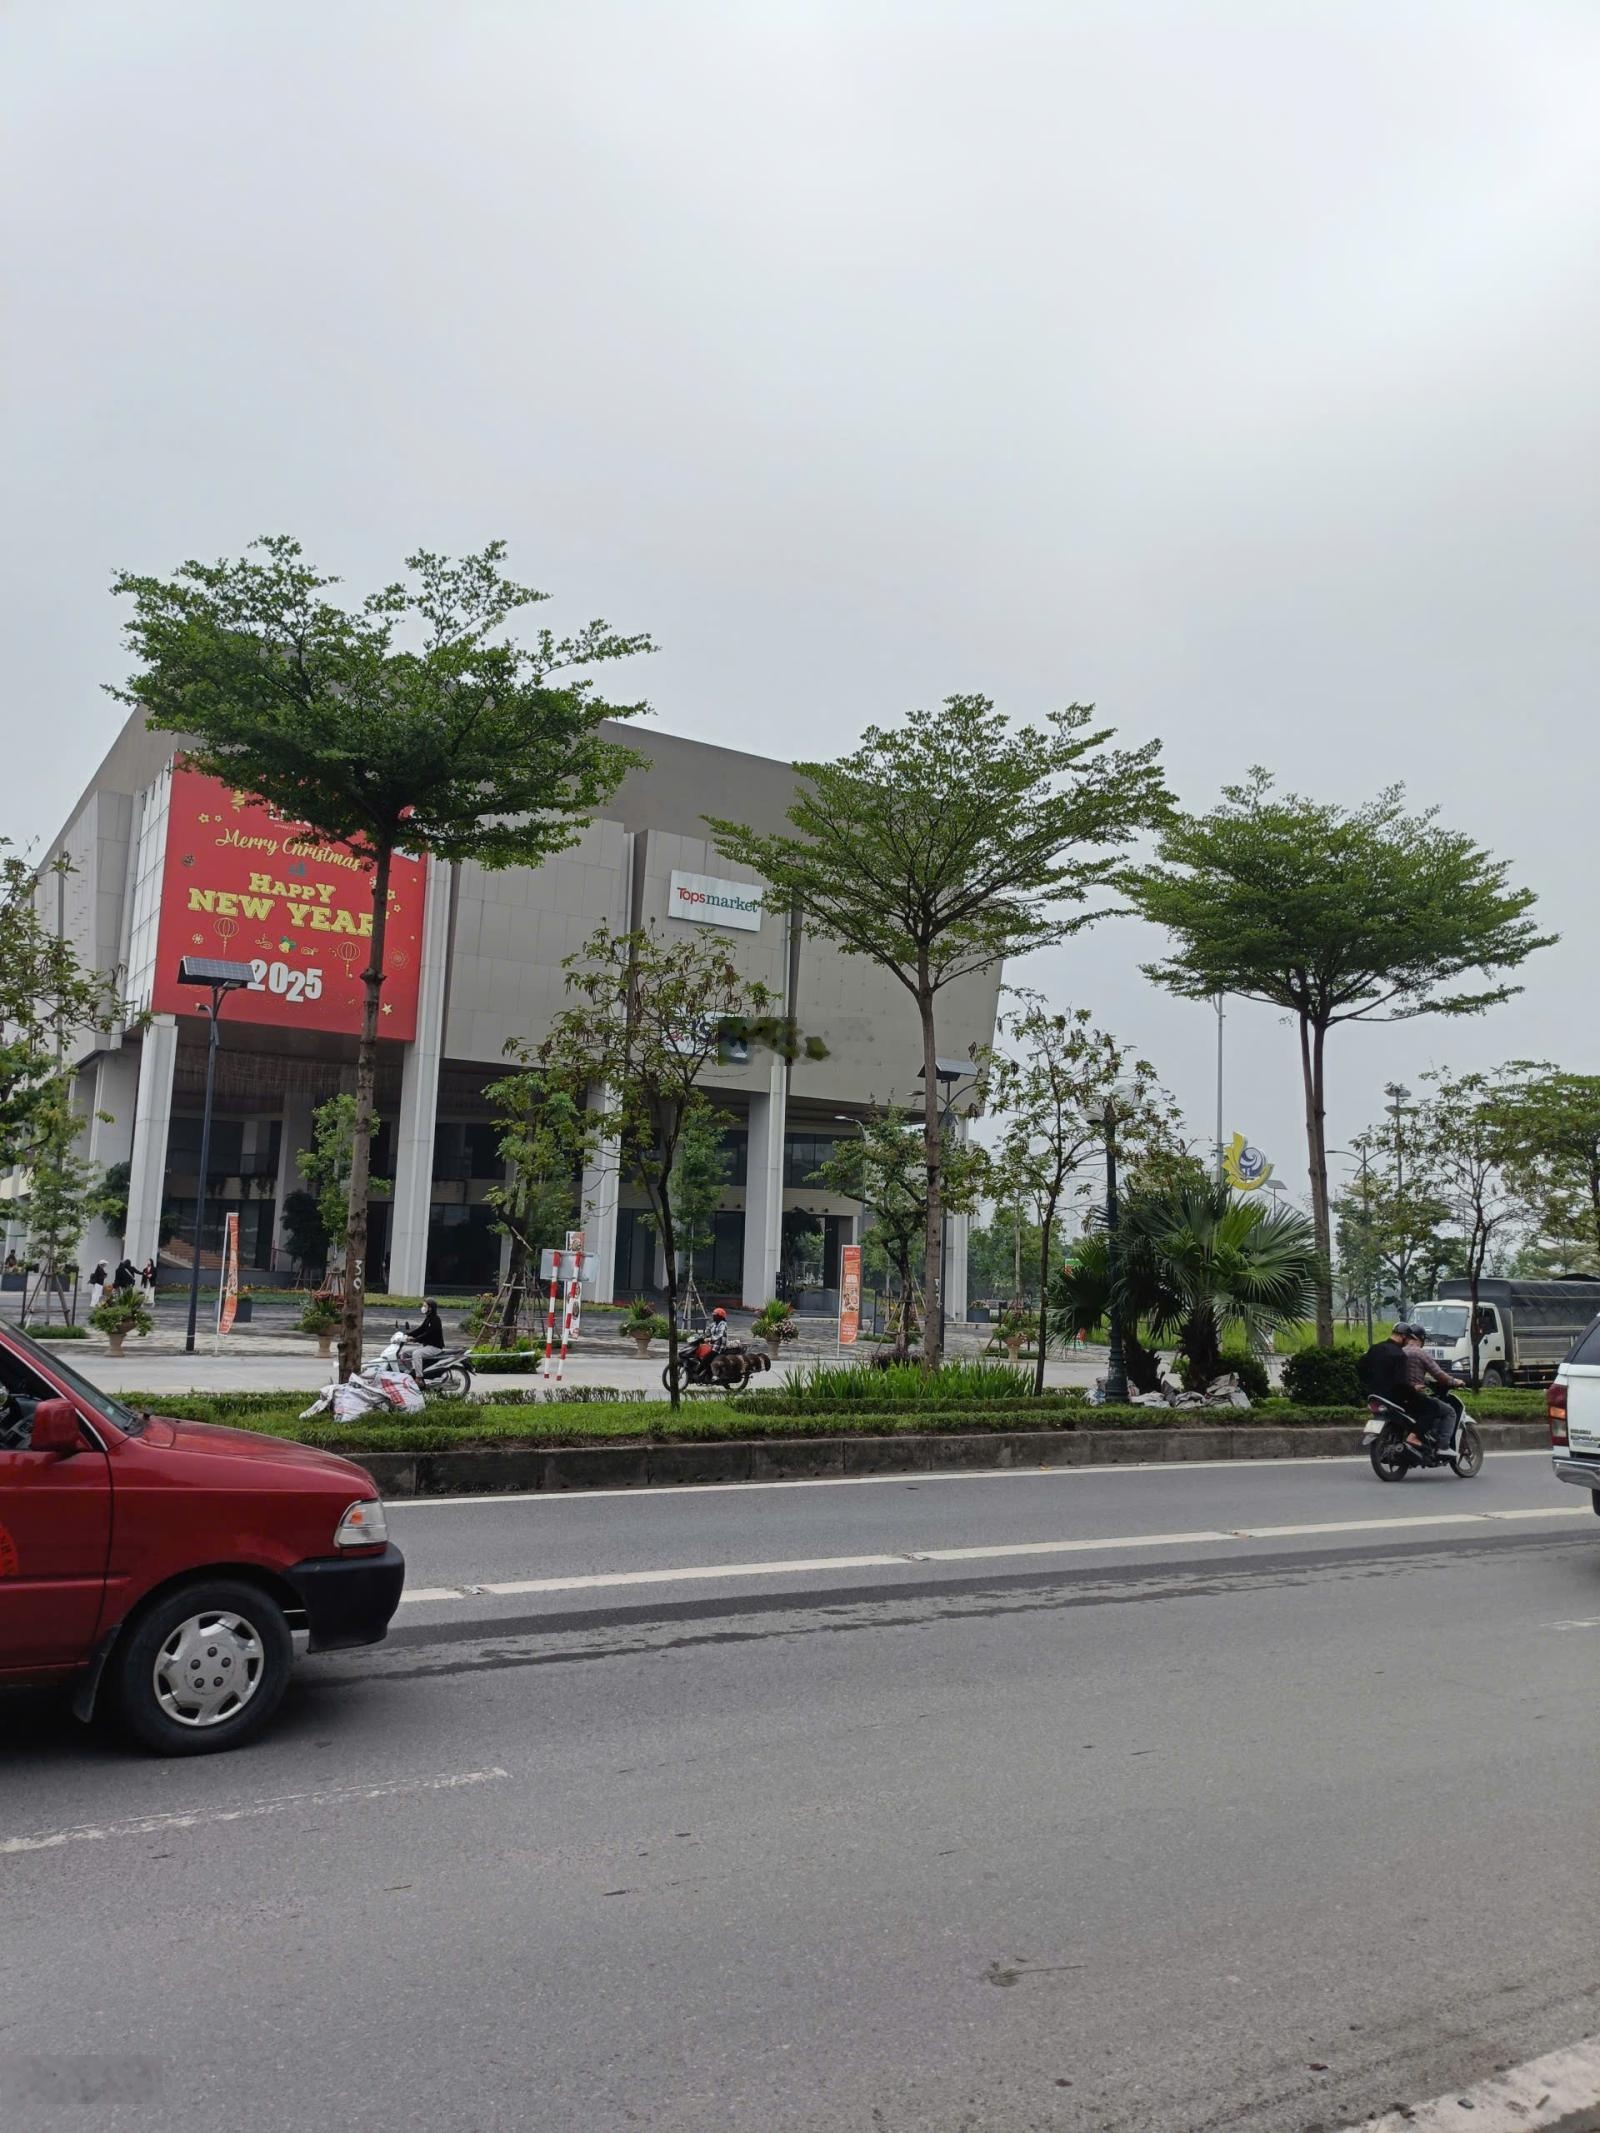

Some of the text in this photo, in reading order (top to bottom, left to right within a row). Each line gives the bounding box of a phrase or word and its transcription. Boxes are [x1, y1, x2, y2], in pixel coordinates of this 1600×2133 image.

[215, 828, 362, 872] Merry Christmas
[187, 887, 276, 921] NEW
[247, 958, 323, 1003] 2025
